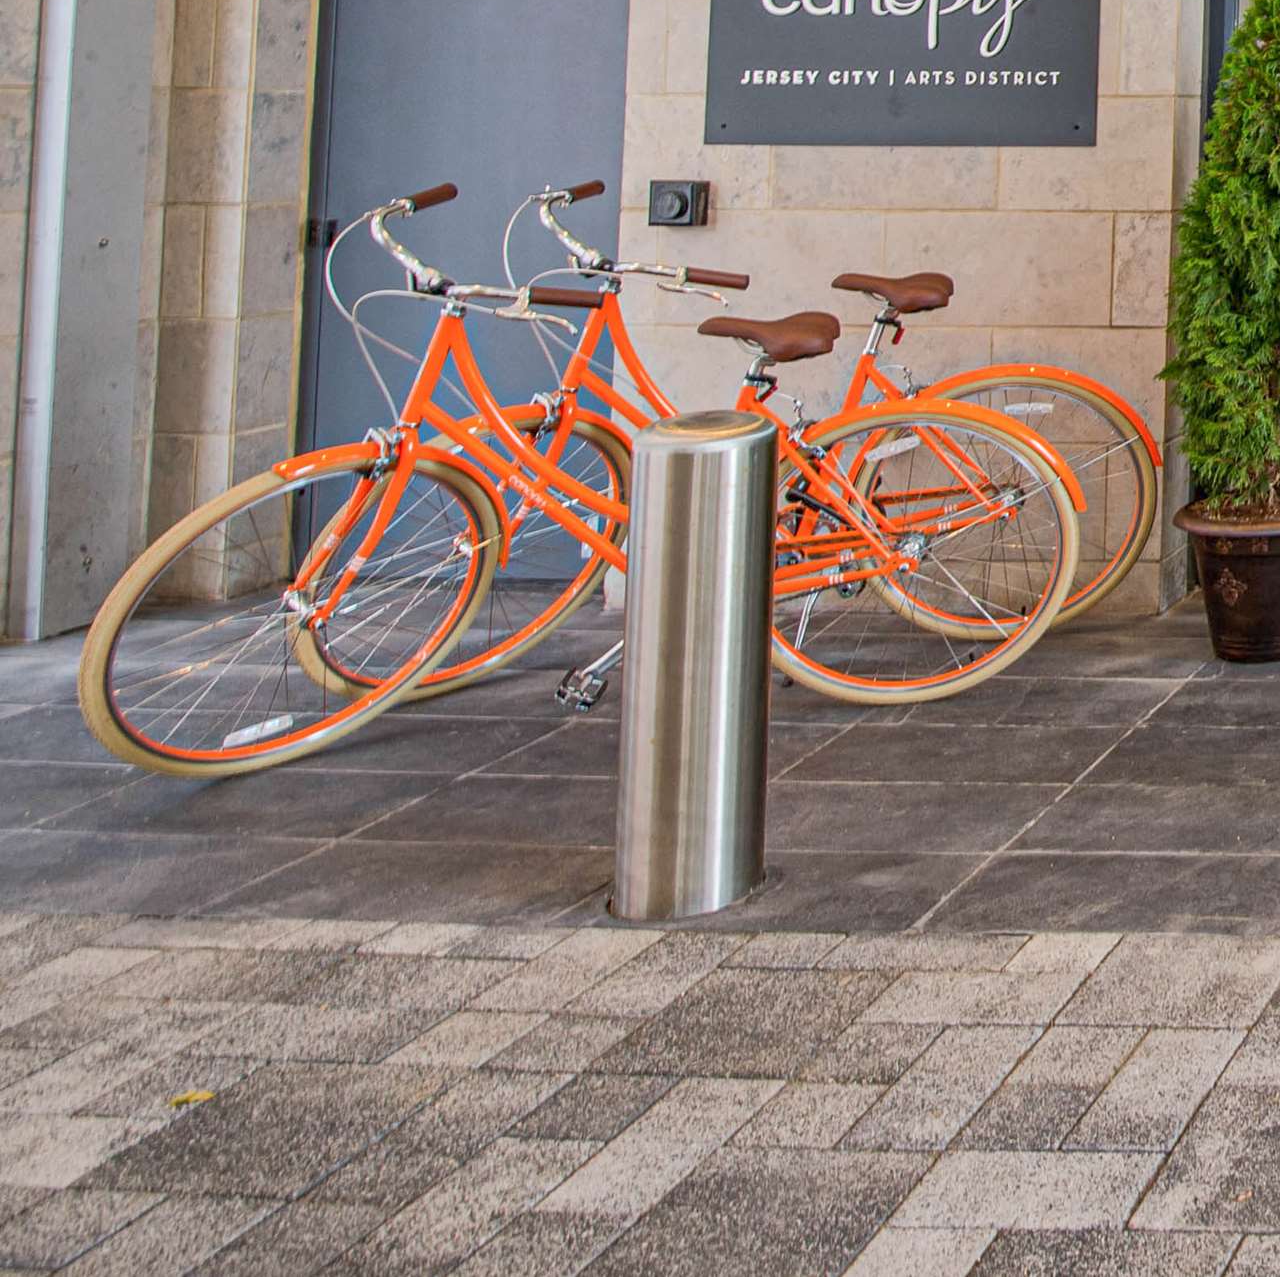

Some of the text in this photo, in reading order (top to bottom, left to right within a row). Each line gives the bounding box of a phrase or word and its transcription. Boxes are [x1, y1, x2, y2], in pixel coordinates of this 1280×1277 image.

[741, 70, 819, 85] JERSEY
[829, 70, 879, 85] CITY
[905, 70, 956, 85] ARTS
[965, 70, 1061, 86] DISTRICT
